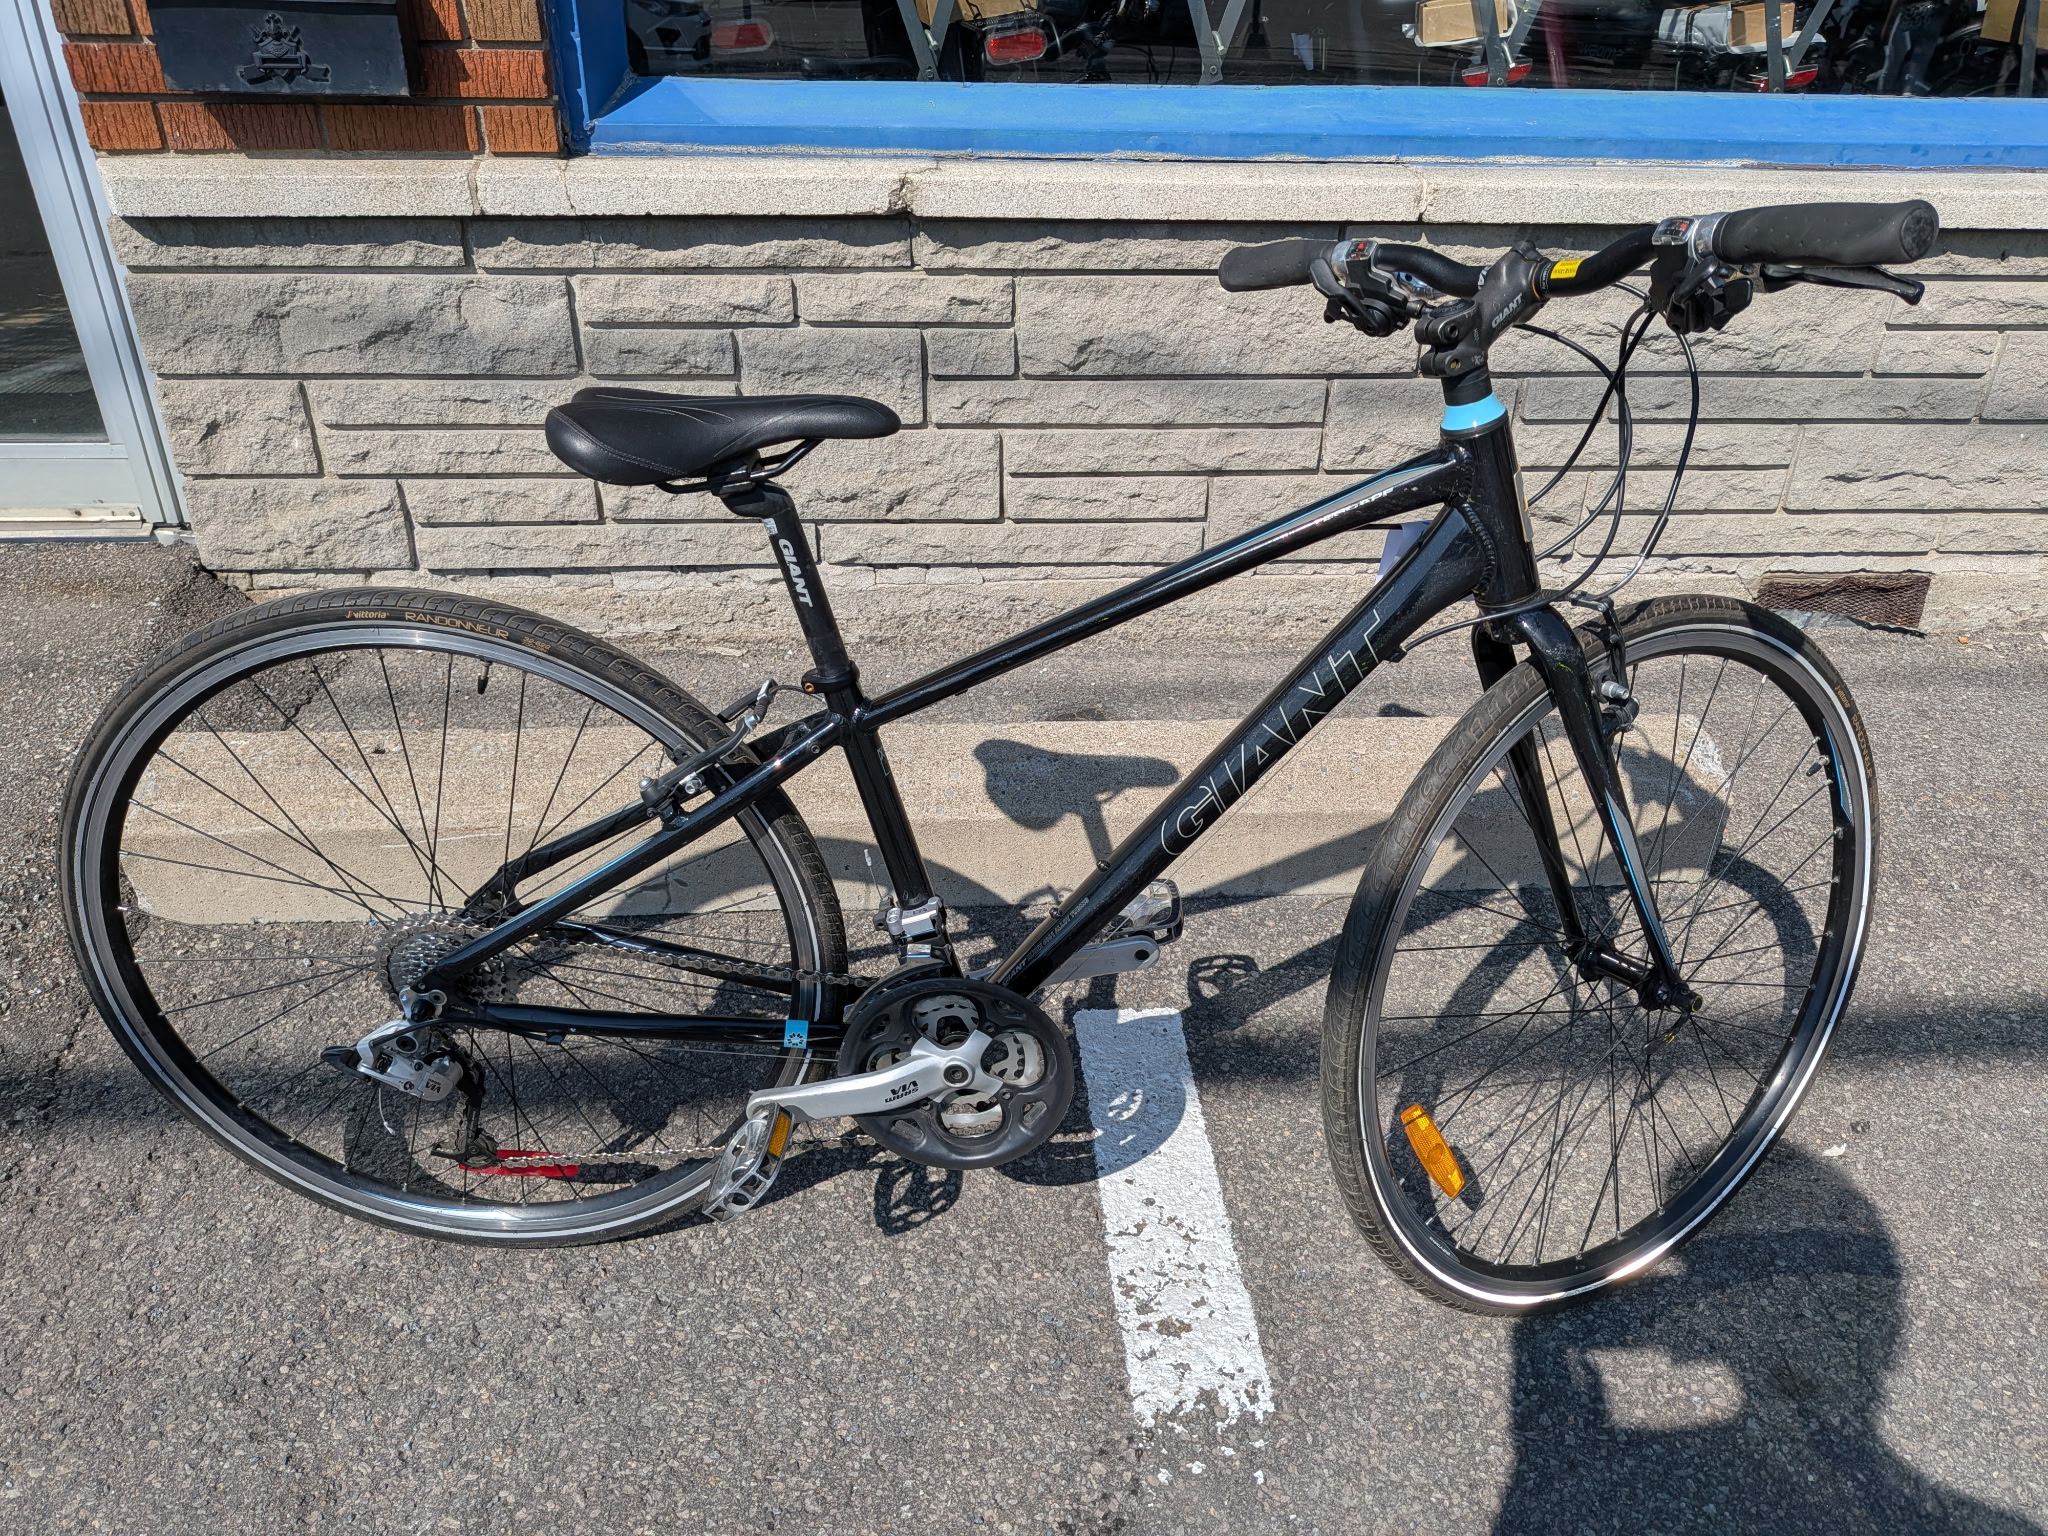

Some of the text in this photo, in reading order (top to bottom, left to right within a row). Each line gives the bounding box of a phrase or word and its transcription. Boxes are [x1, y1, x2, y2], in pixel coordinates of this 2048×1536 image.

[1491, 292, 1523, 329] GIANT
[779, 538, 813, 608] GIANT
[405, 611, 509, 640] RANDONNEUR
[1161, 609, 1381, 856] GIANT
[426, 1081, 441, 1093] VIA
[890, 1080, 919, 1095] VIA
